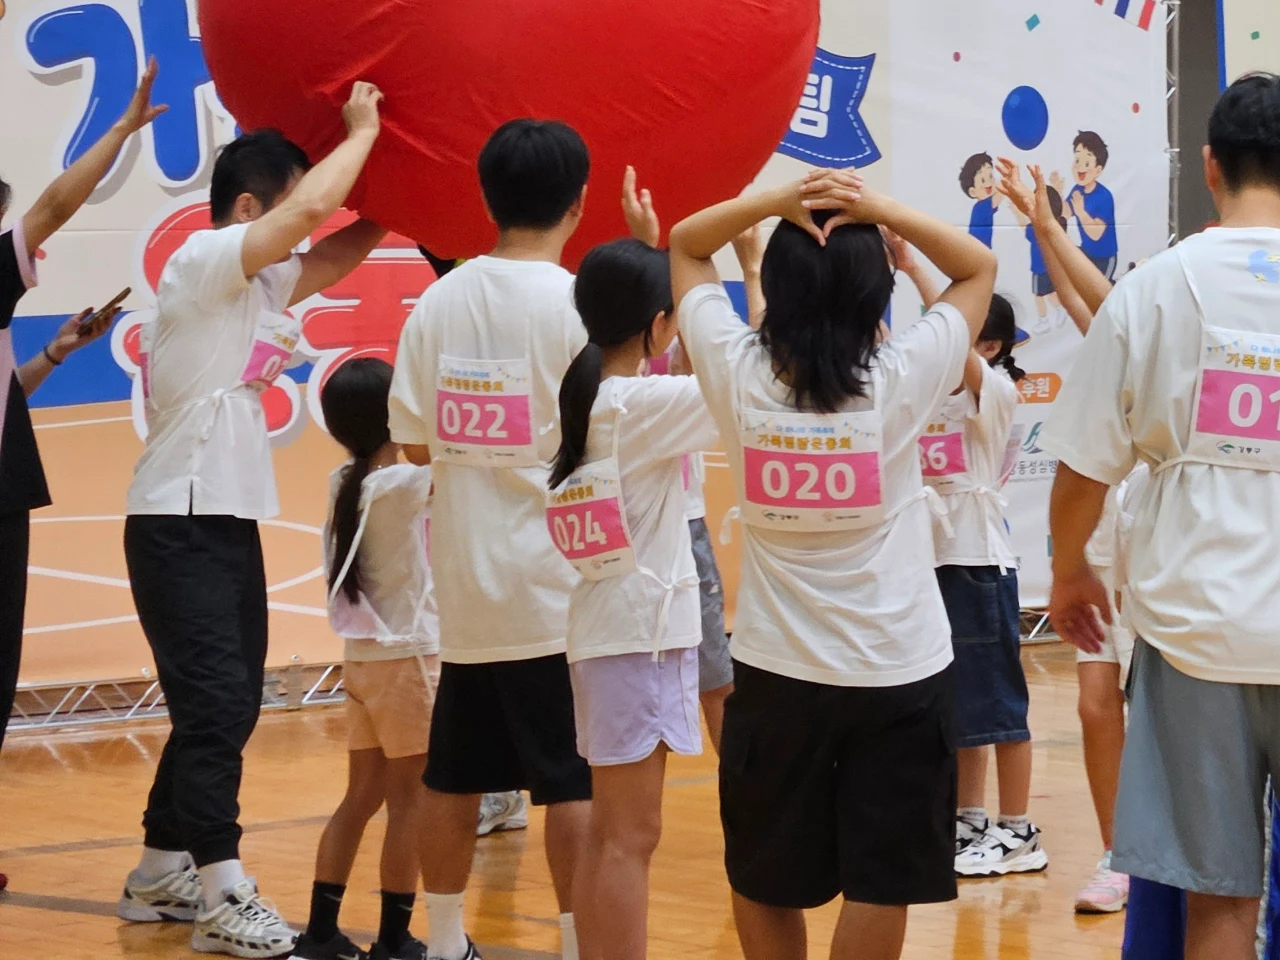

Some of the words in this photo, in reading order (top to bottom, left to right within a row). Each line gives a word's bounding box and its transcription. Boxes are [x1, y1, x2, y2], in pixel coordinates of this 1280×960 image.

[789, 73, 833, 139] 팀
[1022, 377, 1050, 399] 후원
[441, 399, 508, 439] 022
[761, 459, 857, 501] 020
[553, 510, 607, 552] 024
